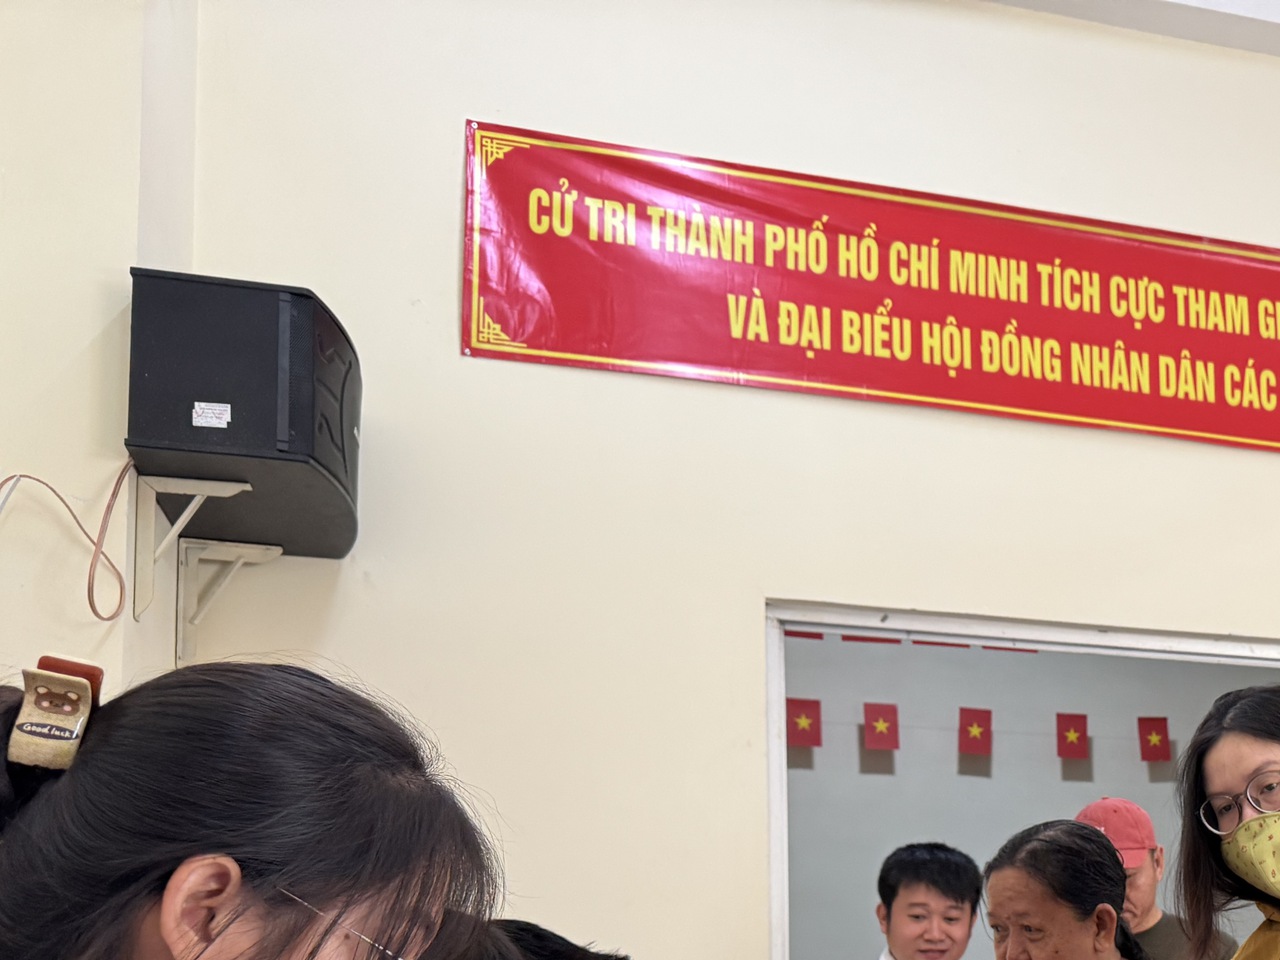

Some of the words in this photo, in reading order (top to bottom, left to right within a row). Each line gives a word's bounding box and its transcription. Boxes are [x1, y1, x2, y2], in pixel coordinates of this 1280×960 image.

[529, 177, 578, 238] CỬ
[585, 196, 636, 246] TRI
[647, 203, 755, 265] THÀNH
[765, 213, 829, 275] PHỐ
[838, 222, 879, 282] HỒ
[889, 237, 940, 291] CHÍ
[950, 249, 1029, 304] MINH
[1037, 257, 1101, 314] TÍCH
[1110, 276, 1165, 330] CỰC
[1173, 286, 1250, 337] THAM
[728, 287, 770, 342] VÀ
[778, 301, 832, 359] ĐẠI
[842, 298, 912, 362] BIỂU
[922, 315, 972, 378] HỘI
[981, 318, 1062, 383] ĐỒNG
[1071, 339, 1151, 395] NHÂN
[1159, 349, 1216, 404] DÂN
[1224, 358, 1278, 412] CÁC
[22, 723, 51, 734] Good
[51, 727, 72, 738] luck
